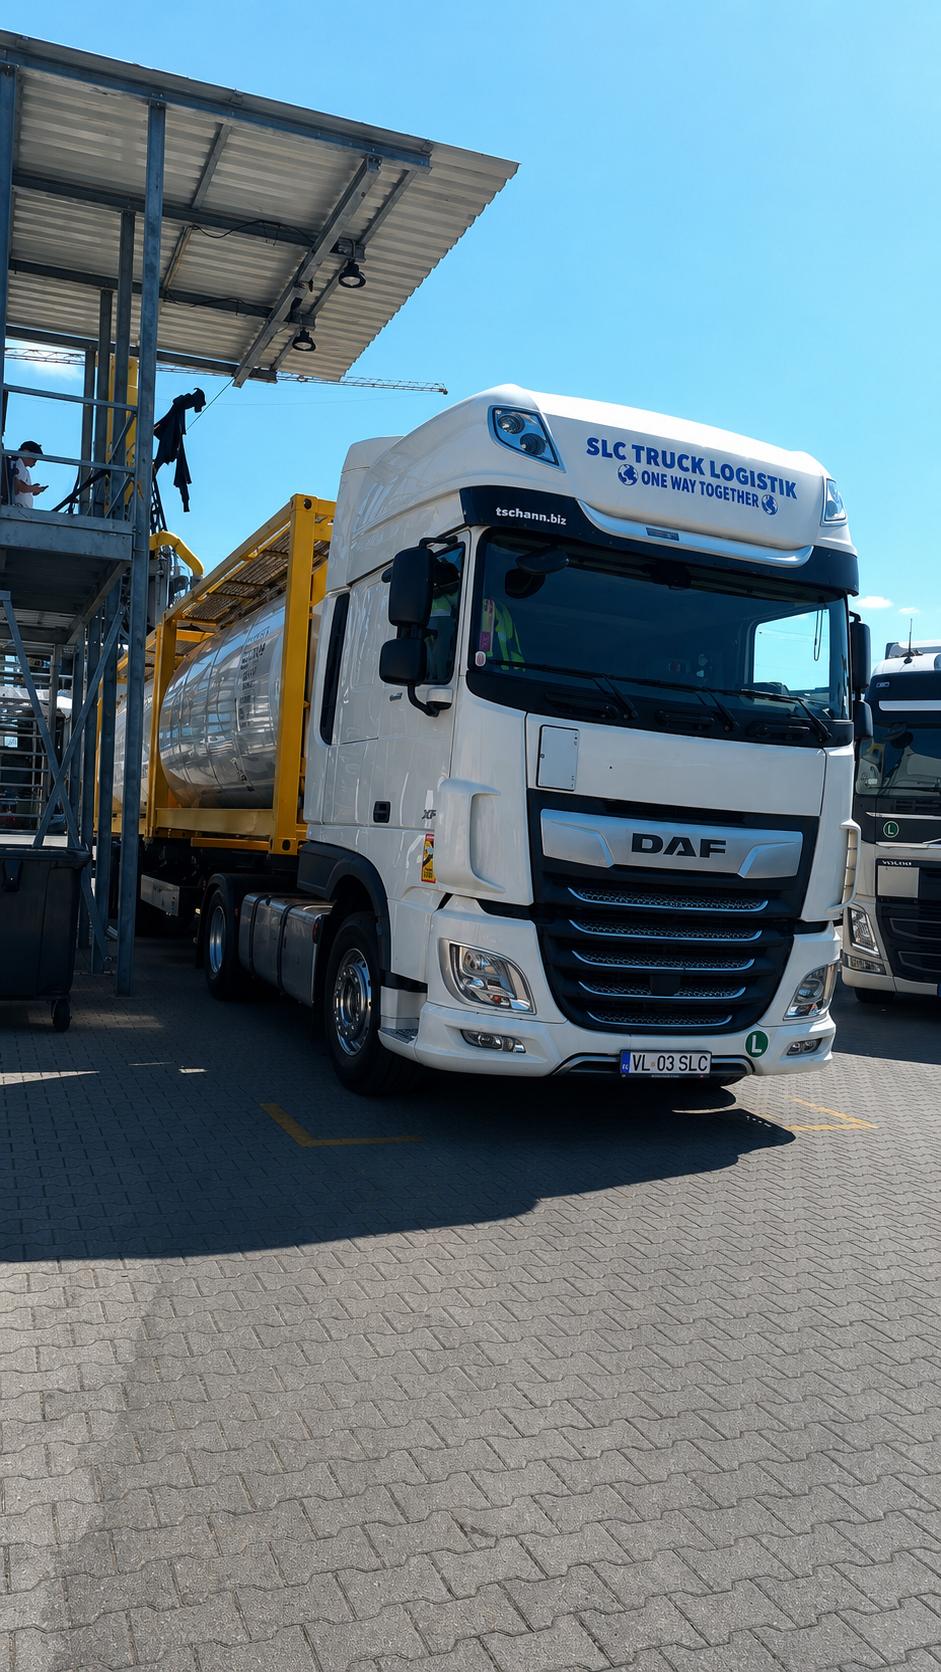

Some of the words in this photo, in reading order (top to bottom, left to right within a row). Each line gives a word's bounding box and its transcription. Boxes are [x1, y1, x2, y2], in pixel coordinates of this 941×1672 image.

[586, 437, 627, 461] SLC
[631, 444, 706, 476] TRUCK
[709, 460, 798, 500] LOGISTIK
[641, 470, 668, 489] ONE
[670, 475, 697, 494] WAY
[699, 481, 760, 509] TOGETHER
[495, 507, 567, 525] tschann.biz
[631, 832, 727, 859] DAF
[751, 1034, 763, 1053] L
[632, 1054, 651, 1072] VL
[657, 1055, 675, 1072] 03
[678, 1055, 708, 1072] SLC
